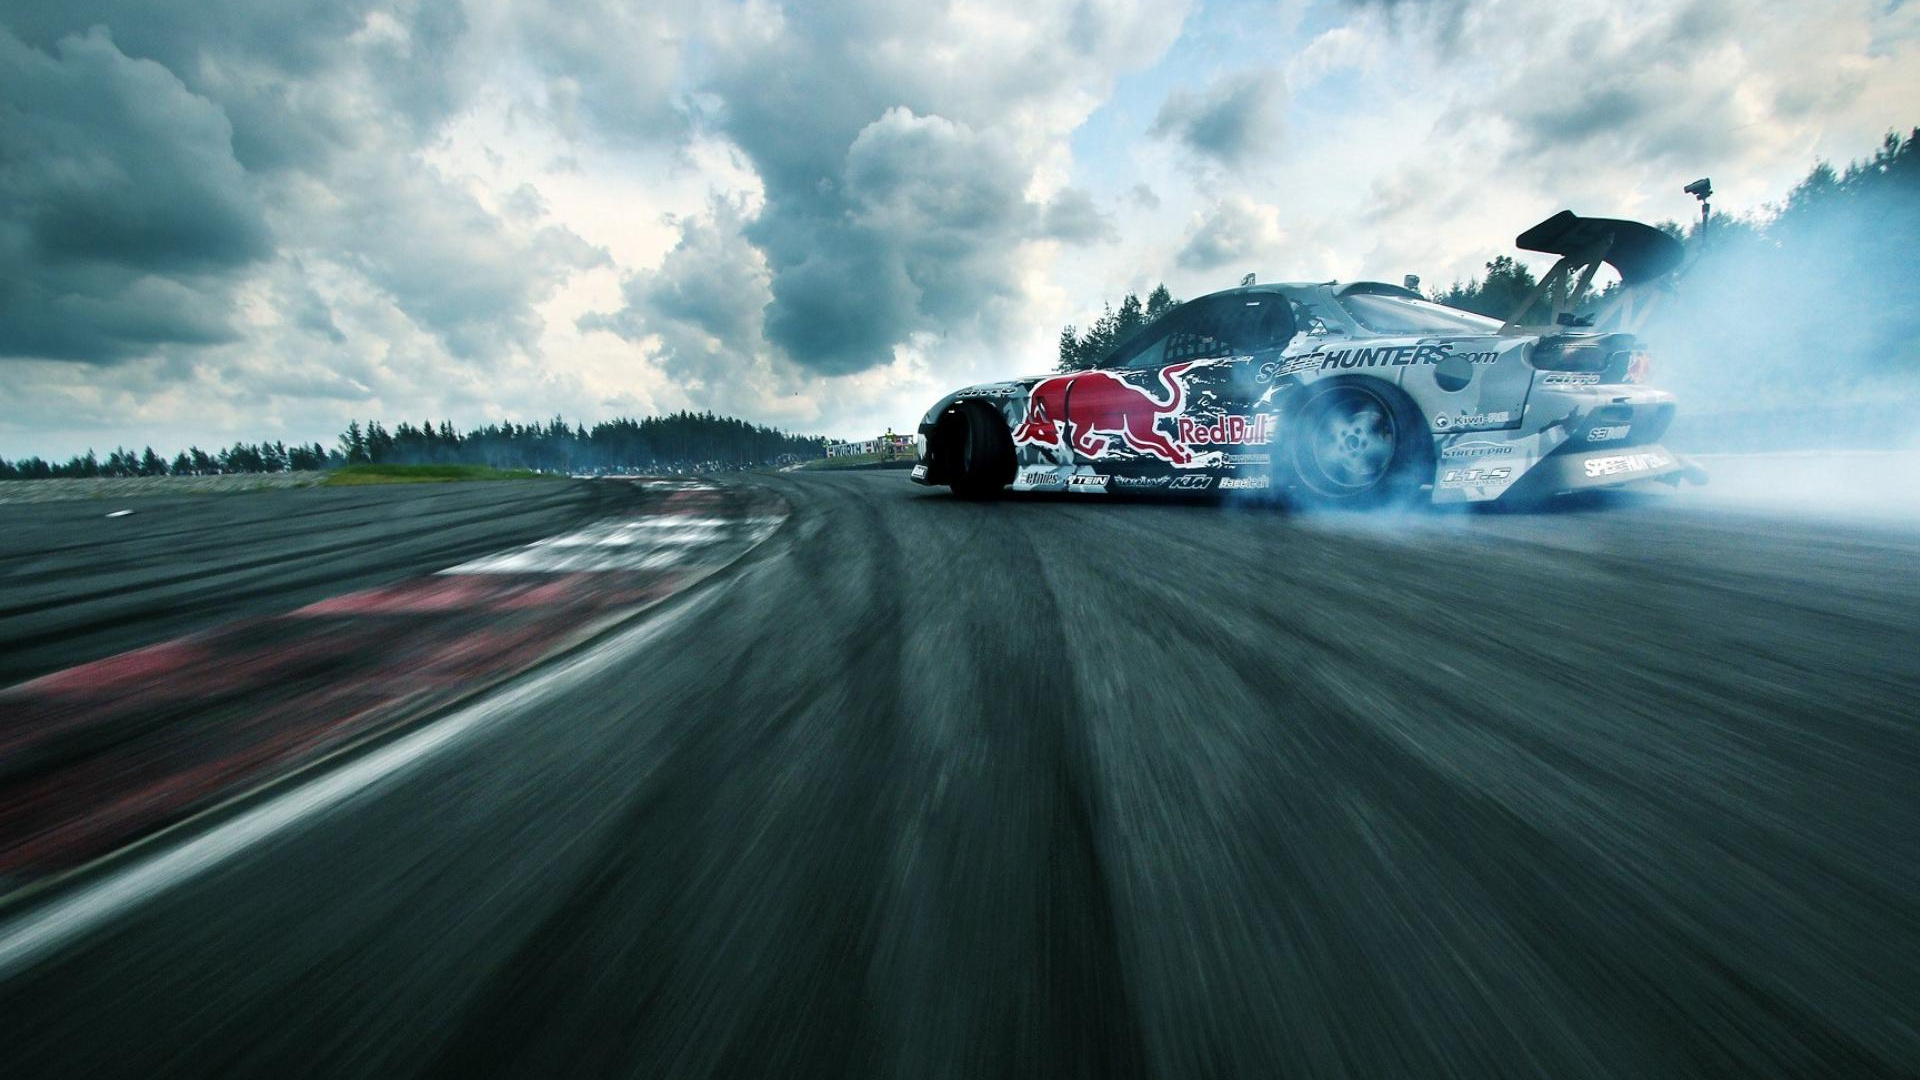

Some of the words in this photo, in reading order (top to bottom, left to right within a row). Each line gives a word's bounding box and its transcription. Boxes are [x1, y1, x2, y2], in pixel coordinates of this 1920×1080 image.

[1179, 414, 1227, 445] Red
[1228, 413, 1269, 445] Bull
[1026, 471, 1059, 486] etnies
[1077, 475, 1107, 485] TEIN
[1169, 474, 1213, 489] KTM
